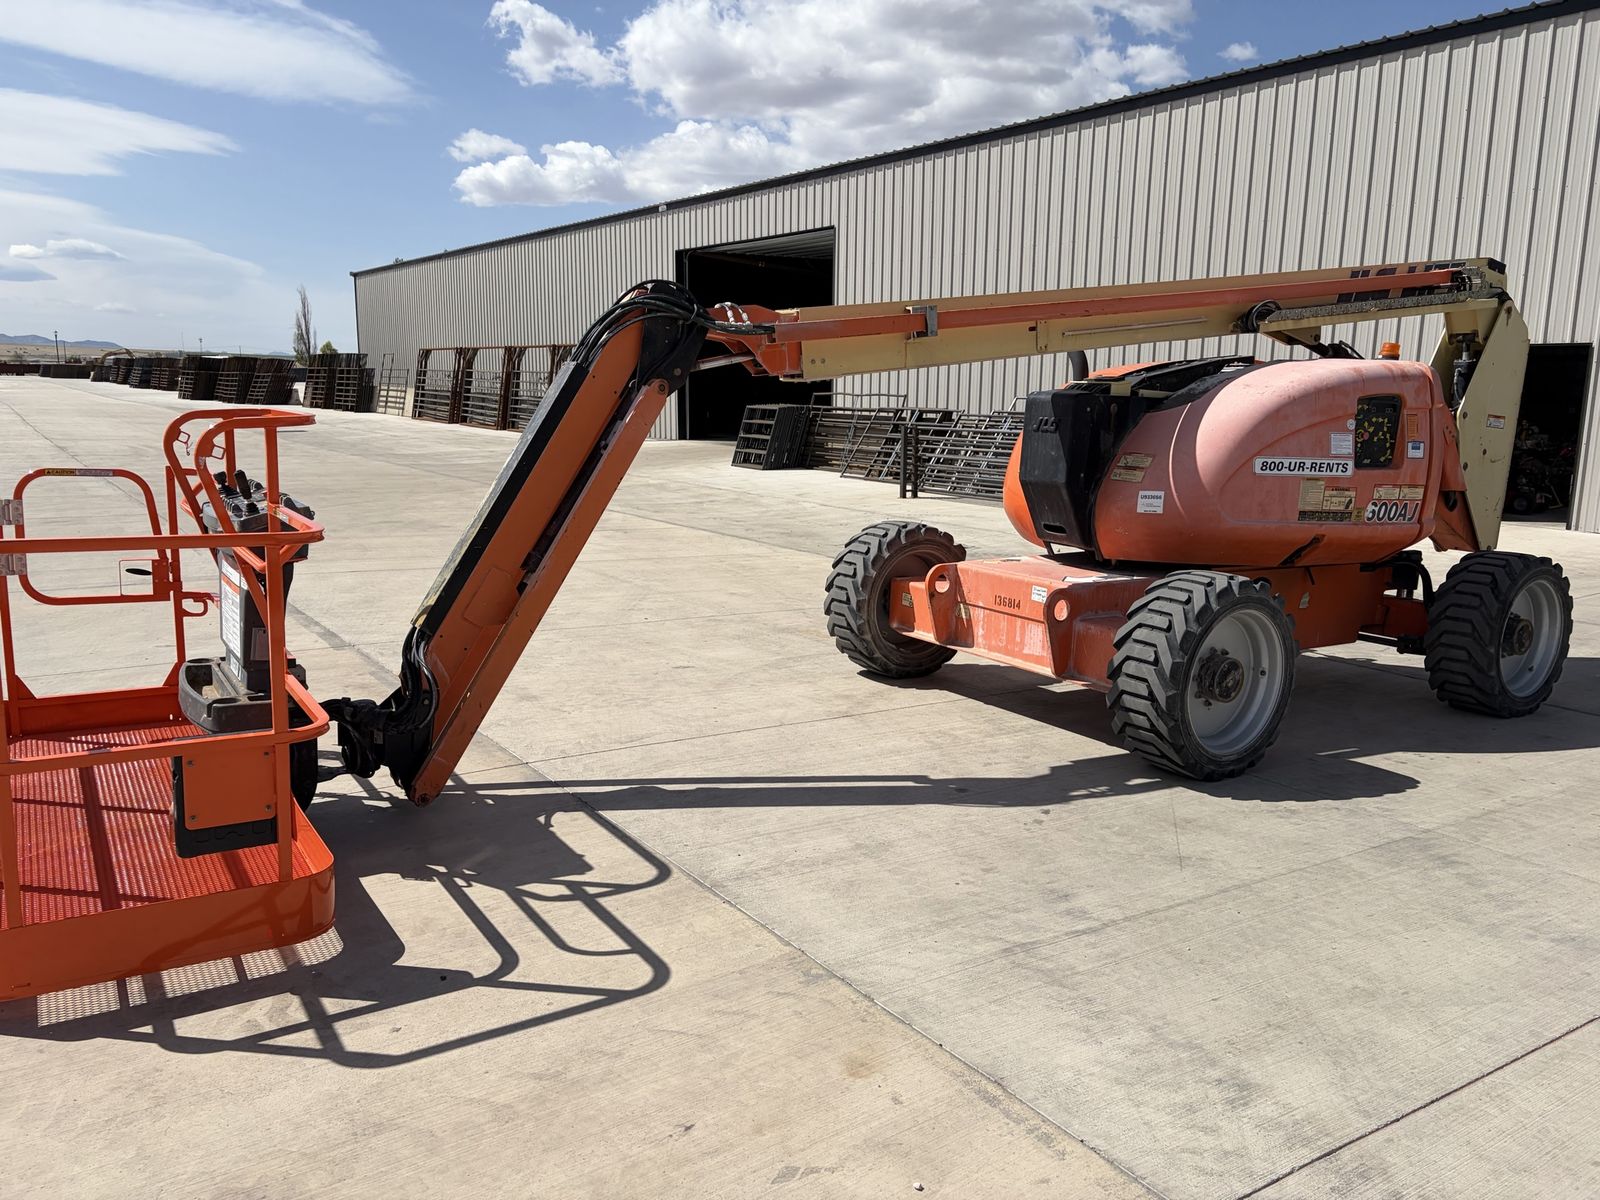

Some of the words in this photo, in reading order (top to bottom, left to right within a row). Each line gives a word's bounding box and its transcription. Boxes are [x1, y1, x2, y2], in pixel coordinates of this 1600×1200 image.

[1032, 416, 1058, 433] JLG
[1260, 461, 1349, 473] 800-UR-RENTS
[994, 594, 1021, 610] 136814
